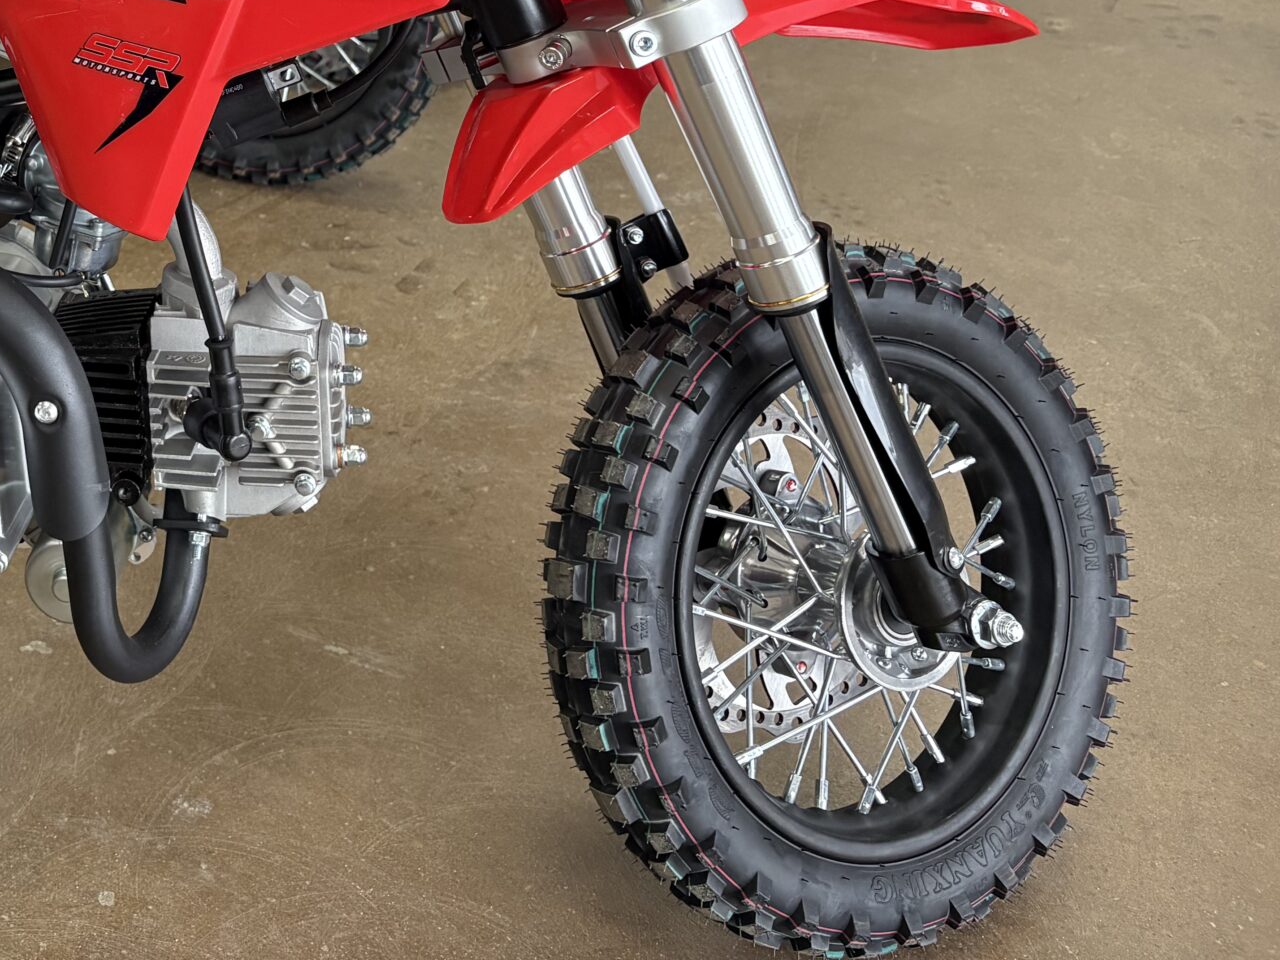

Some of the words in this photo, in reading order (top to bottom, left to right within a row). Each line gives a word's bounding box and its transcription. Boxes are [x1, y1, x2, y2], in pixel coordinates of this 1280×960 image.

[73, 57, 156, 86] MOTORSPORTS
[76, 32, 181, 89] SSR
[1072, 492, 1100, 572] NYLON
[871, 810, 1026, 904] YUANXING
